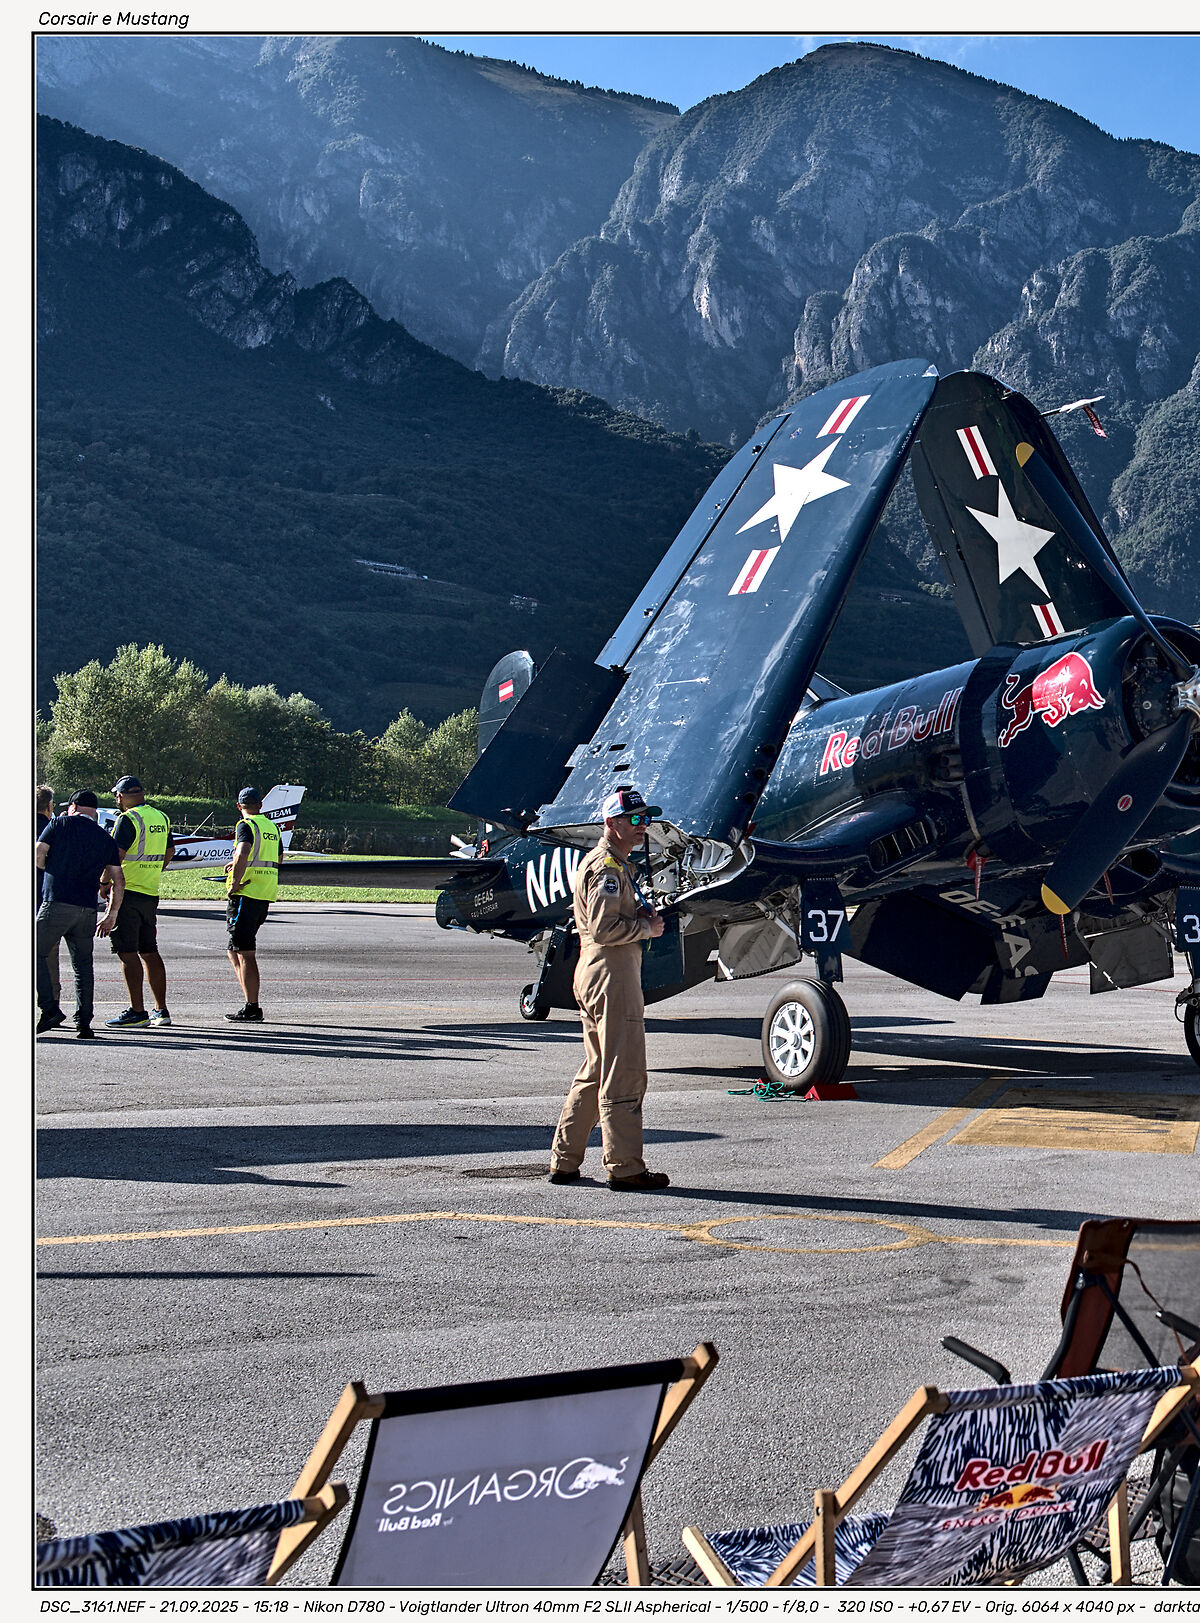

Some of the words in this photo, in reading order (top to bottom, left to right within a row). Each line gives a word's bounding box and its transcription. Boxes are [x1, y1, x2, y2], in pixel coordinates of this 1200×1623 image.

[820, 712, 891, 776] Red
[888, 686, 965, 752] Bull
[269, 808, 292, 820] TEAM
[526, 847, 582, 914] NAV
[807, 909, 845, 942] 37
[954, 1451, 1039, 1492] Red
[1035, 1439, 1110, 1481] Bull
[940, 1511, 1014, 1531] ENERGY
[1015, 1501, 1075, 1521] DRINK
